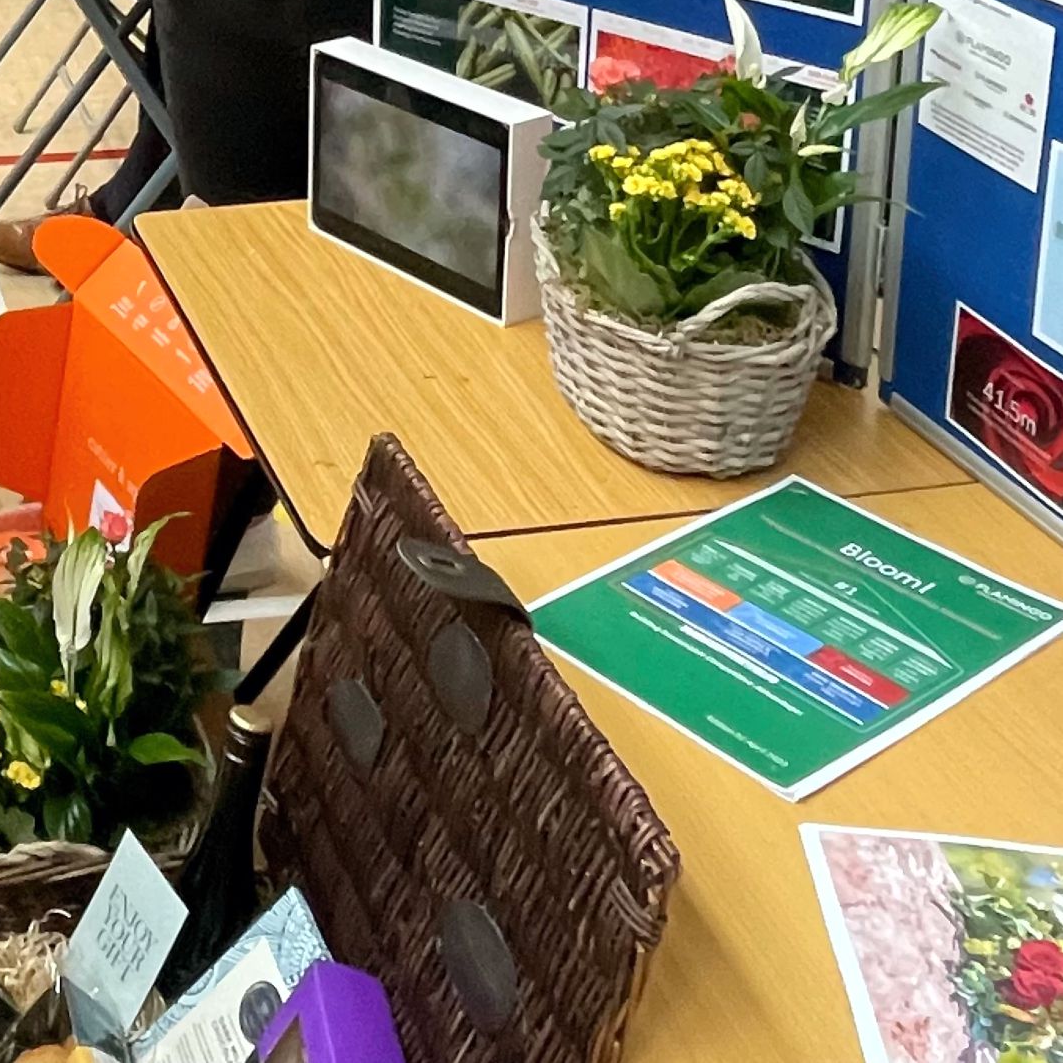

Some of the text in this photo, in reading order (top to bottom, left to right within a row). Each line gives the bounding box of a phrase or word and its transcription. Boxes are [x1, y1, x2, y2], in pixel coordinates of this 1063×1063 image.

[982, 382, 1037, 436] 41.5m
[839, 542, 937, 595] Bloom!
[109, 883, 158, 953] ENJOY
